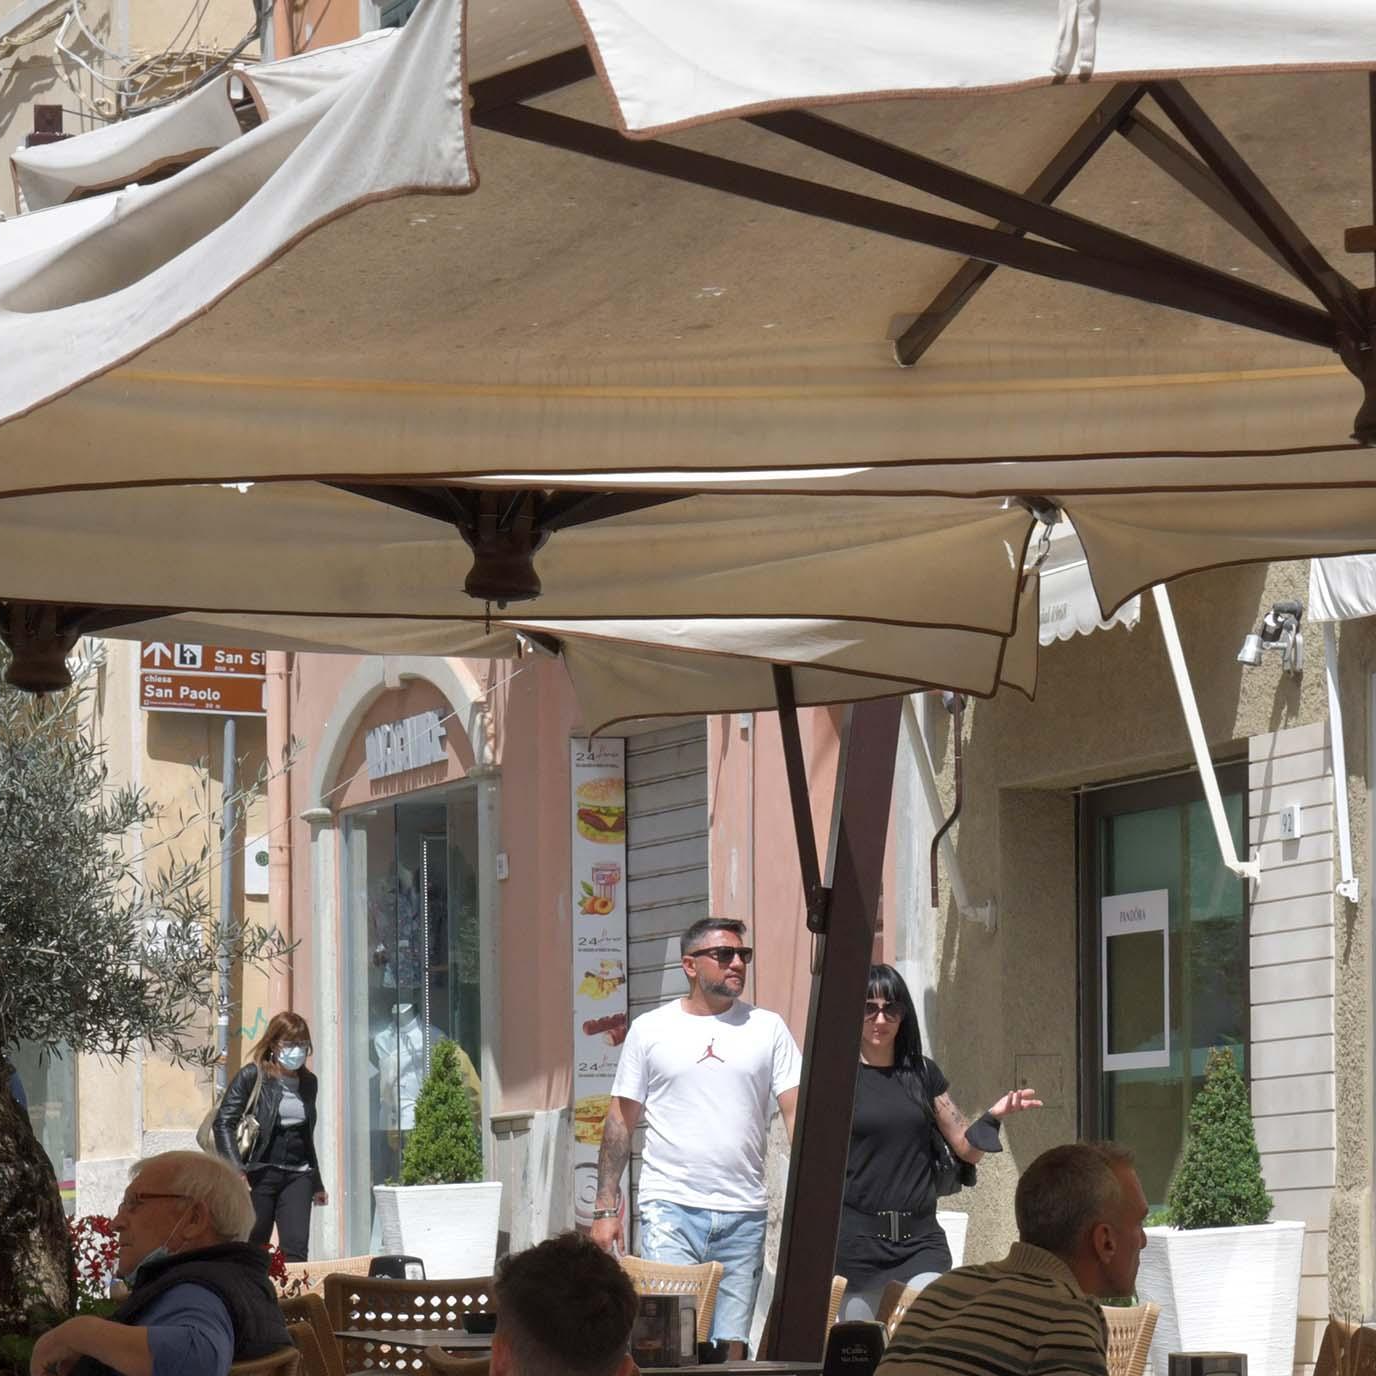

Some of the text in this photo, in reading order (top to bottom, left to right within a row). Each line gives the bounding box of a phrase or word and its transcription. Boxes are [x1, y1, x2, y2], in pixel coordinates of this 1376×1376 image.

[214, 650, 243, 664] San
[144, 675, 172, 683] chiesa
[144, 684, 221, 700] San Paolo
[1281, 812, 1292, 833] 92
[578, 936, 597, 946] 24
[578, 1063, 598, 1071] 24
